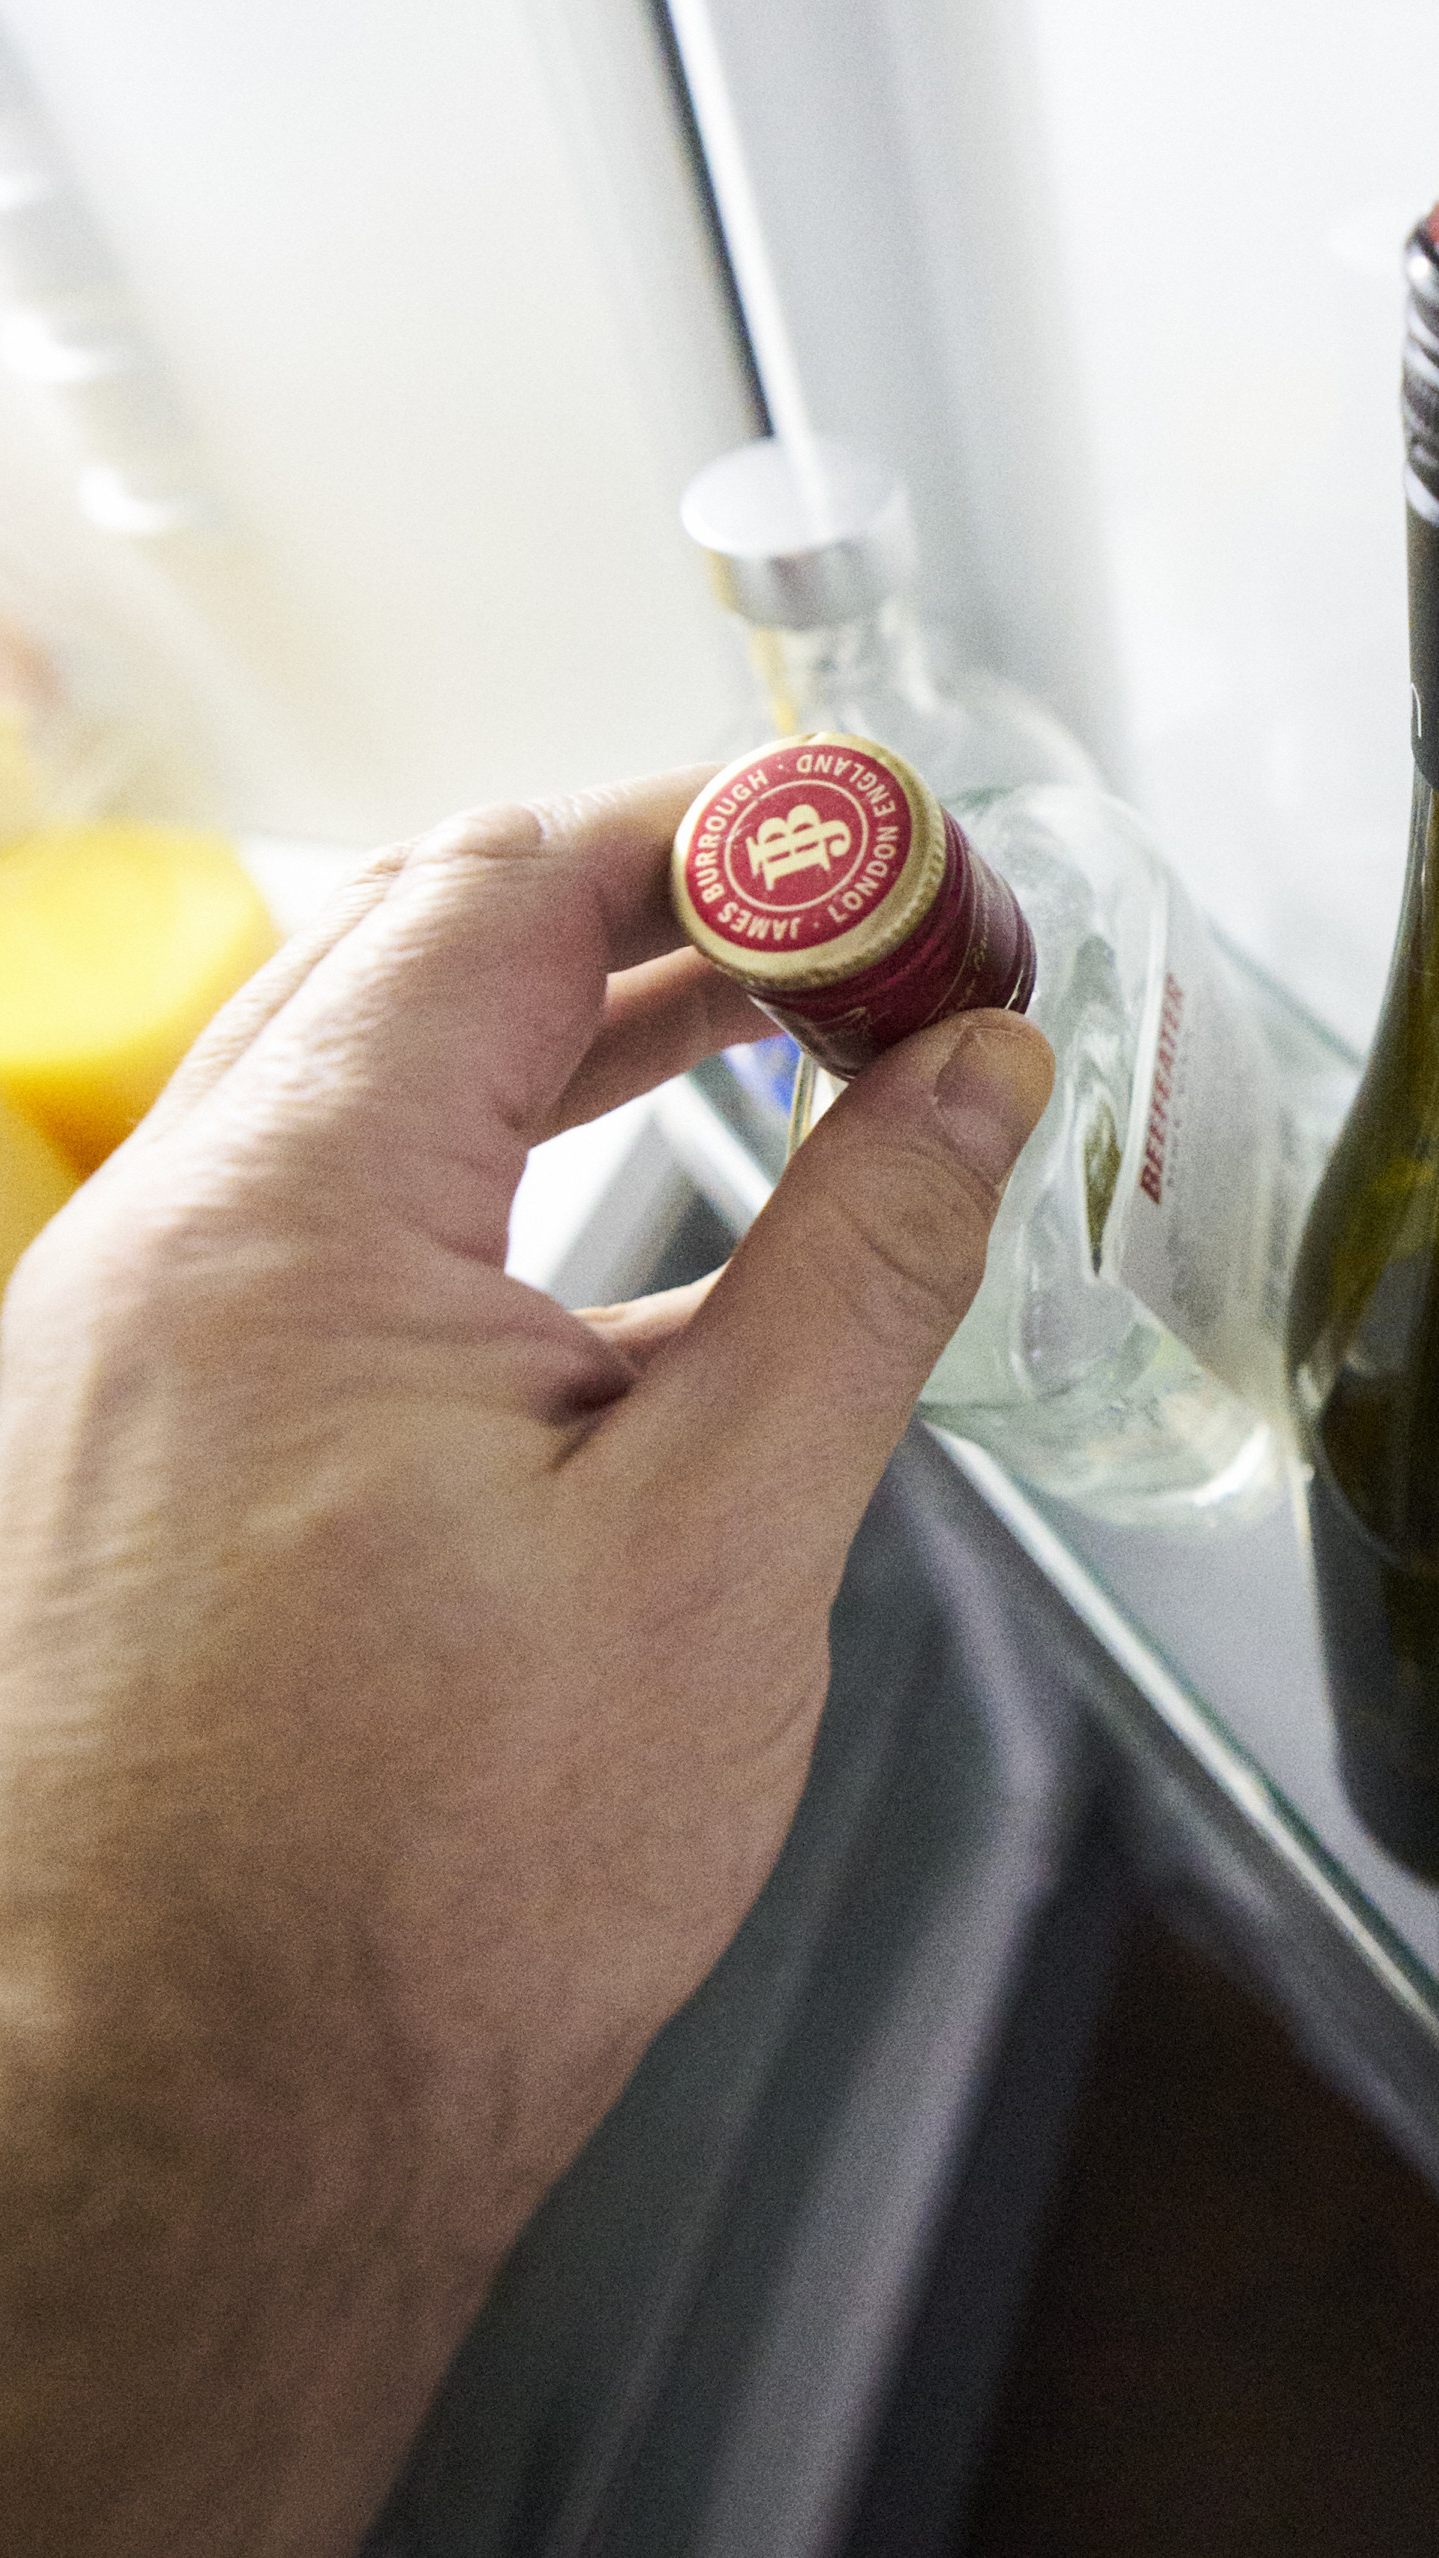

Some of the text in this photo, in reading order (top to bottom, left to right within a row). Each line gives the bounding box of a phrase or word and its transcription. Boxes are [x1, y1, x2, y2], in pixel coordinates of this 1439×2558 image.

[696, 770, 801, 940] JAMES BURROUGH
[796, 753, 898, 923] LONDON ENGLAND
[1140, 972, 1184, 1204] BEEFEATER
